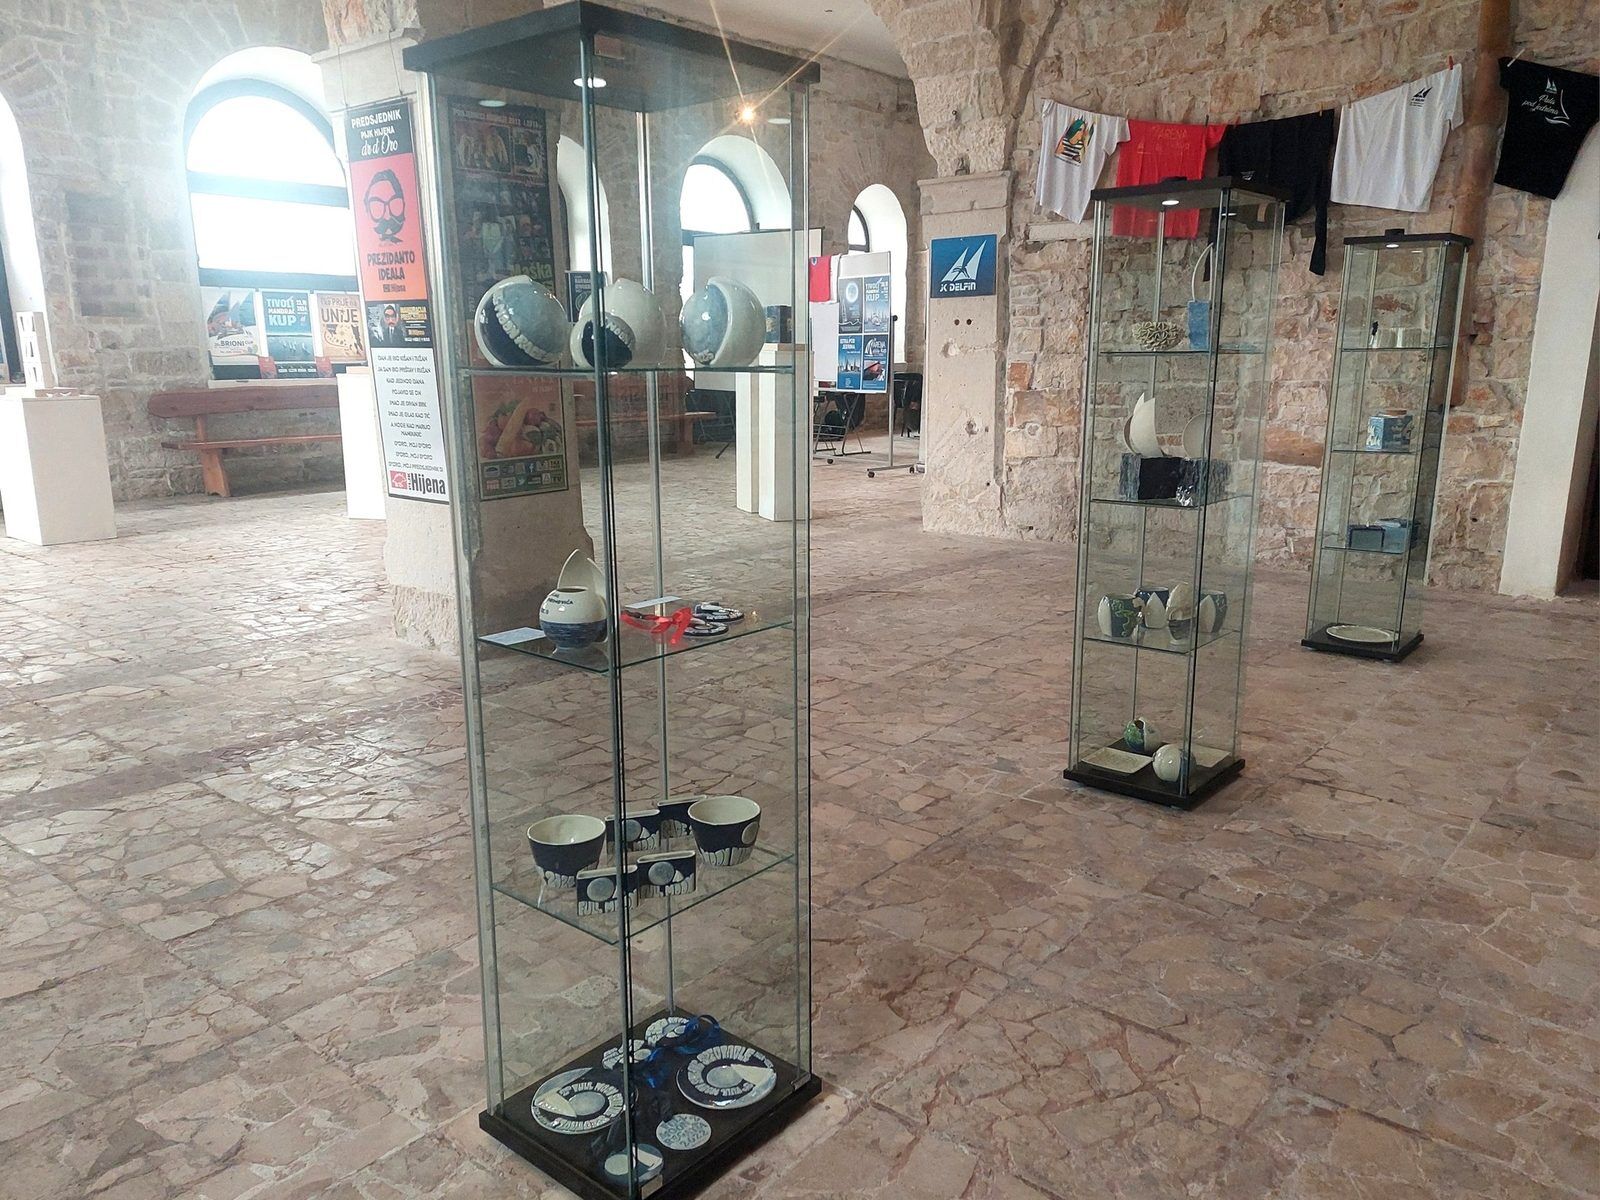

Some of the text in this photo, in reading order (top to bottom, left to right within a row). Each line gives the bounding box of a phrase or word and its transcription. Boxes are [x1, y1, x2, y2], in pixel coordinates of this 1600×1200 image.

[351, 109, 402, 129] PREDSJEDNIK
[367, 250, 415, 265] PREZIDANTO
[378, 266, 406, 281] IDEALA
[948, 281, 977, 292] DELFIN
[269, 314, 297, 327] KUP
[410, 472, 447, 495] Hijena
[578, 900, 604, 917] FULL
